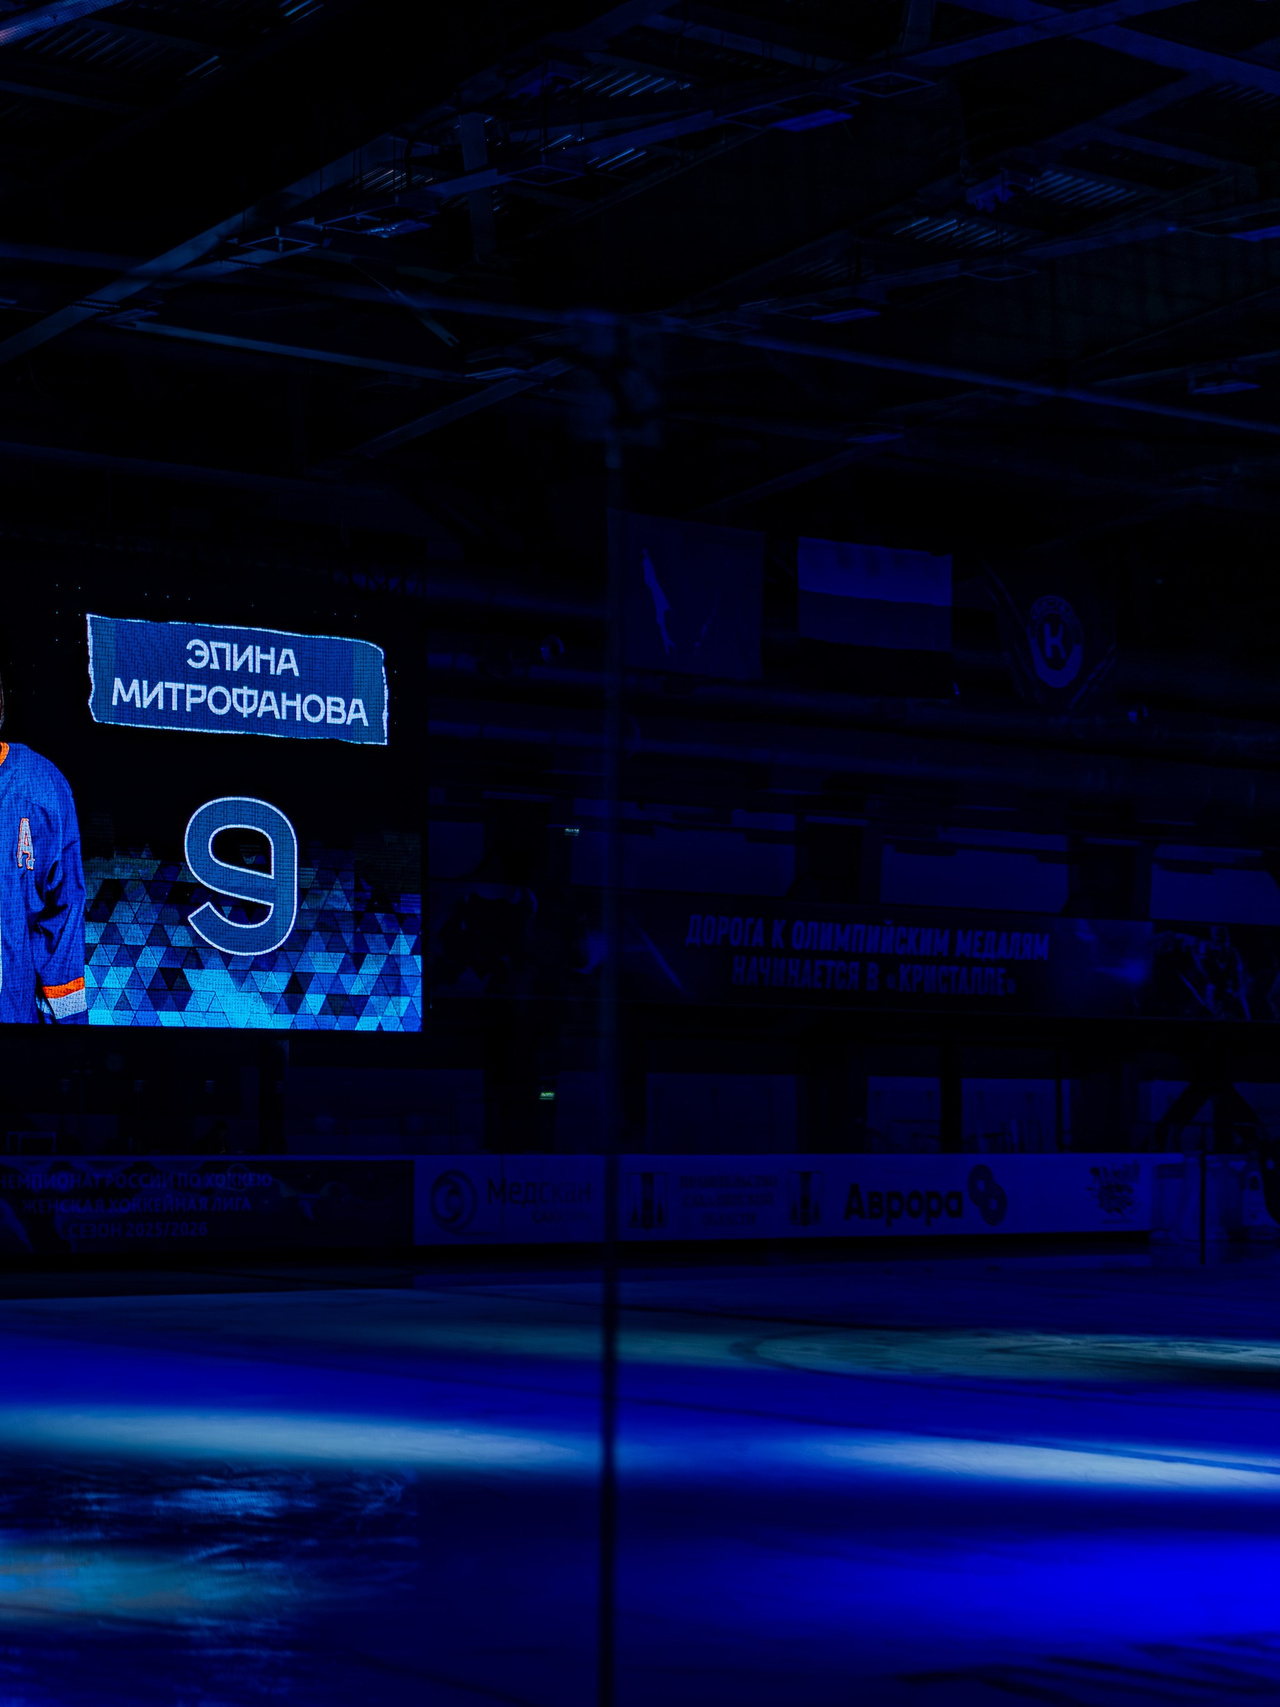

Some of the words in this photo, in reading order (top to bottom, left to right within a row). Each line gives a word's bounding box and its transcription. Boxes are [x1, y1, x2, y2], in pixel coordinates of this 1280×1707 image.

[185, 638, 300, 677] ЭЛИНА
[111, 677, 370, 727] МИТРОФАНОВА
[184, 796, 298, 956] 9
[684, 913, 765, 949] ДОРОГА
[771, 918, 787, 949] К
[791, 919, 950, 957] ОЛИМПИЙСКИМ
[955, 929, 1050, 962] МЕДАЛЯМ
[731, 954, 861, 992] НАЧИНАЕТСЯ
[866, 961, 880, 992] В
[107, 1172, 173, 1189] РОССИИ
[177, 1172, 201, 1188] ПО
[204, 1171, 274, 1188] ХОККЕЮ
[487, 1177, 592, 1208] Медскан
[22, 1198, 105, 1215] ЖЕНСКАЯ
[108, 1194, 208, 1213] ХОККЕЙНАЯ
[211, 1196, 253, 1212] ЛИГА
[843, 1182, 963, 1228] Аврора
[68, 1221, 122, 1240] СЕЗОН
[126, 1221, 208, 1239] 2025/2026
